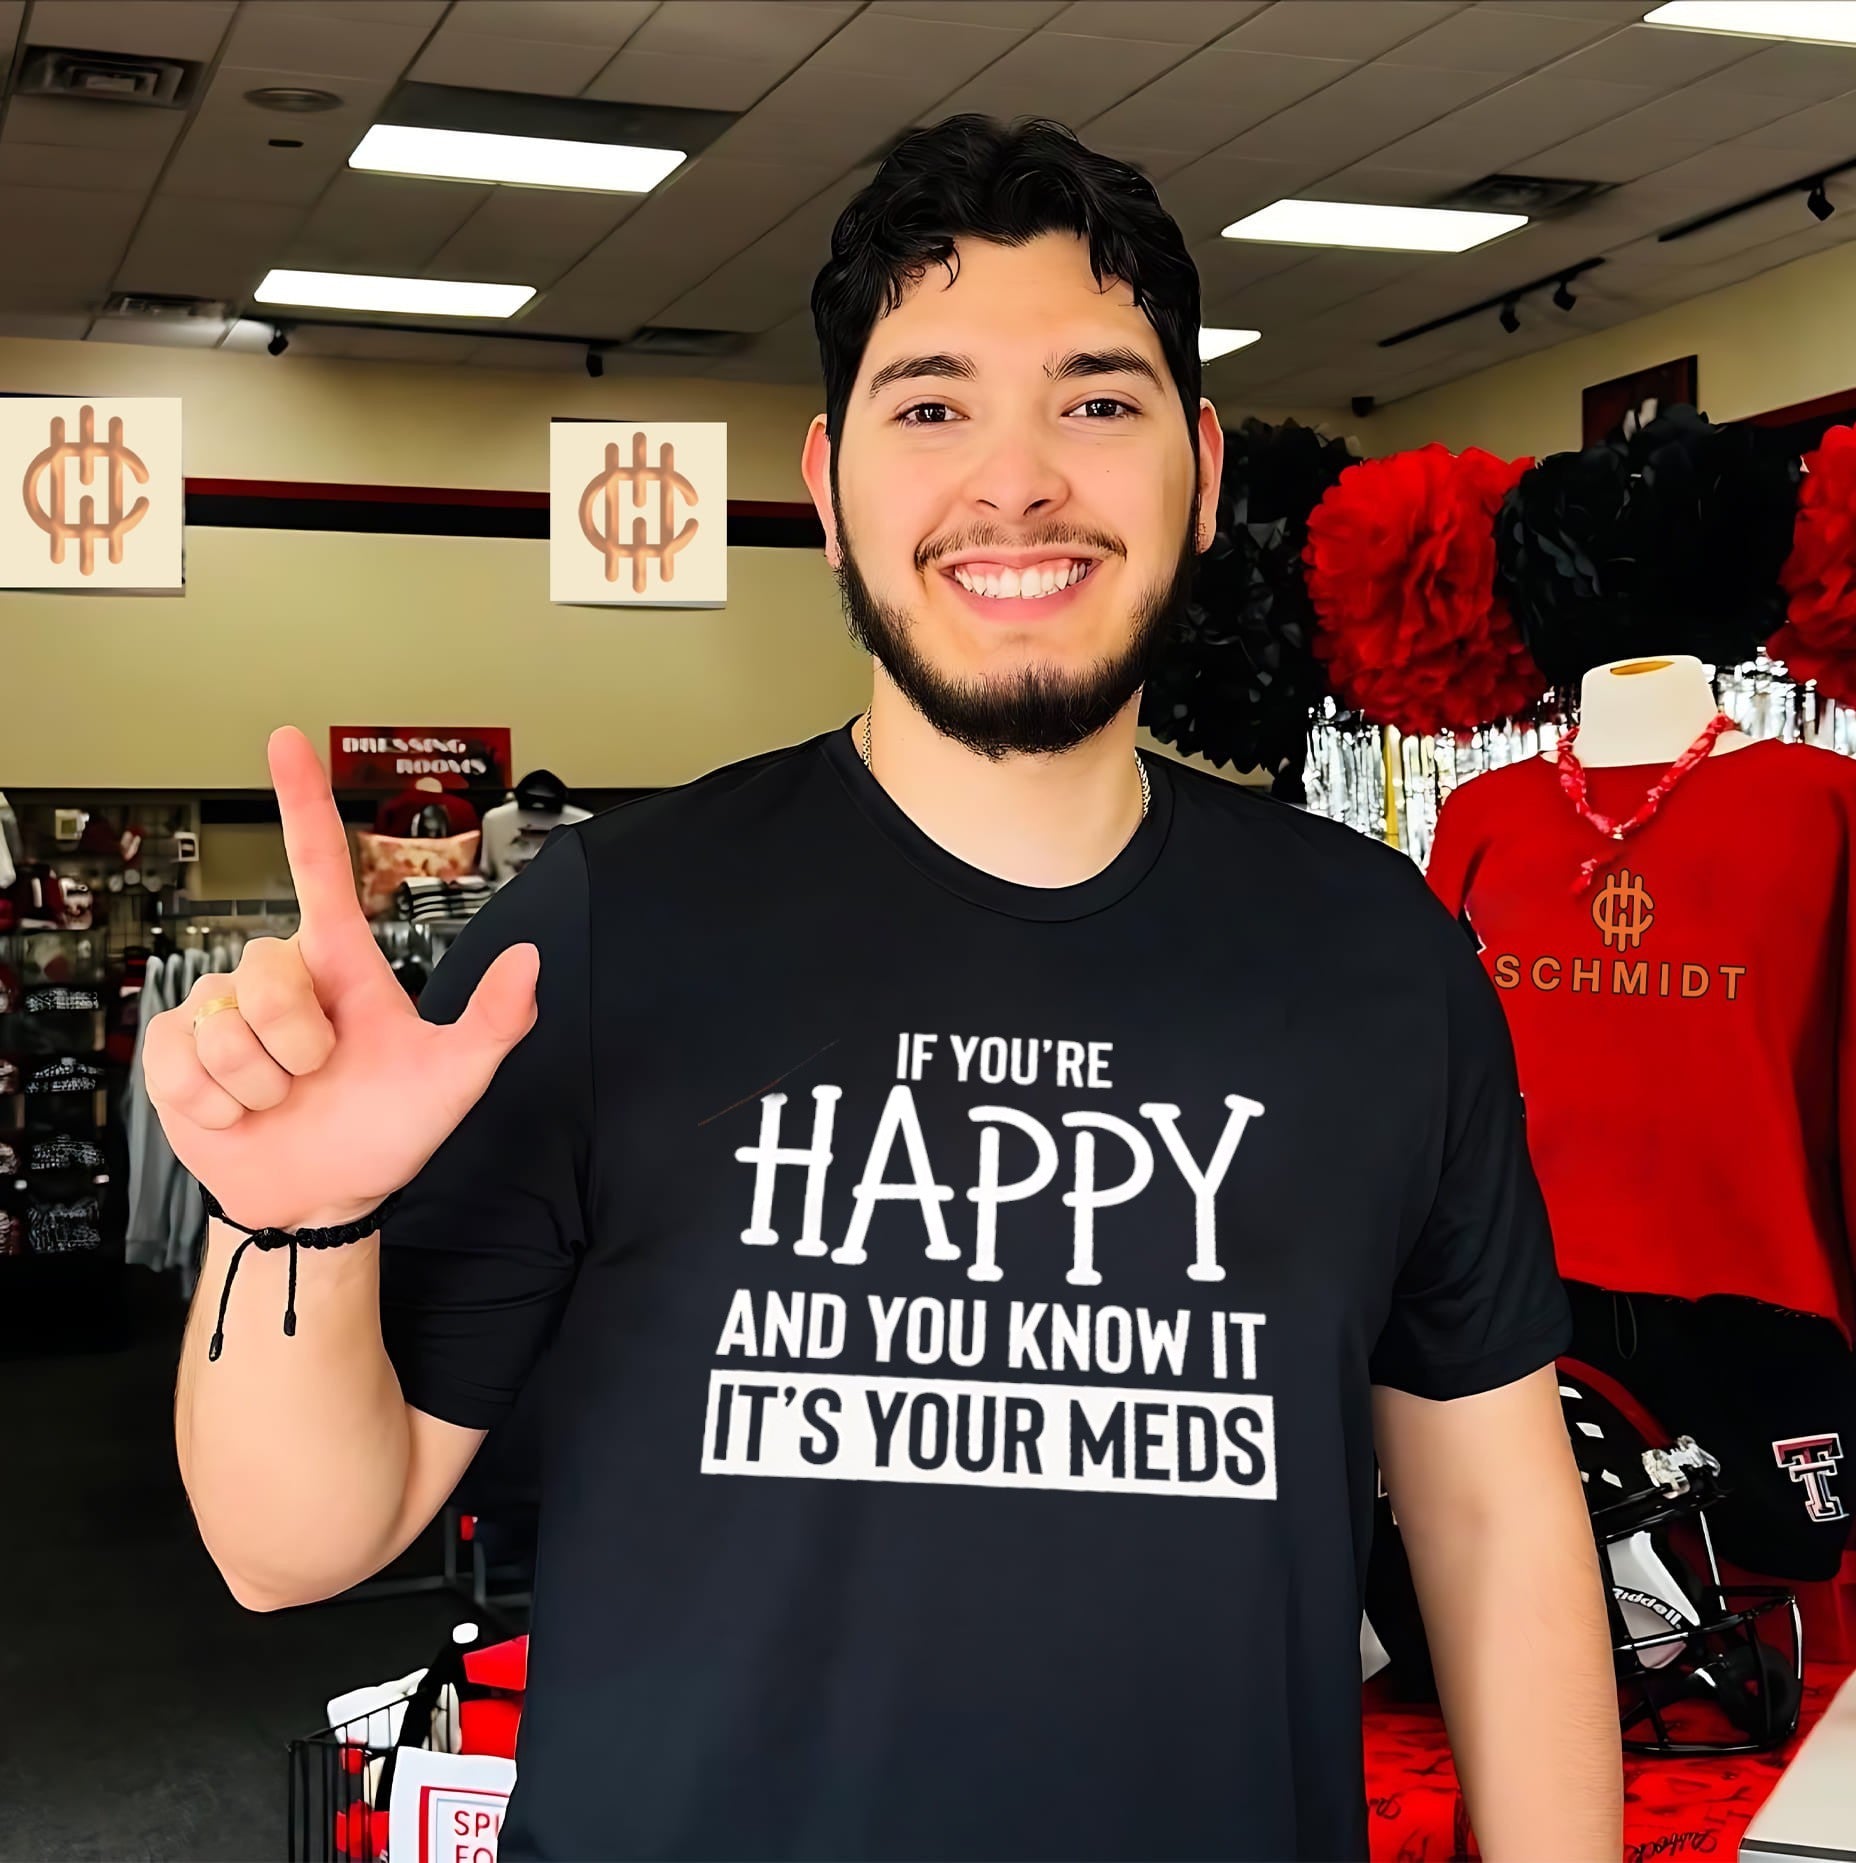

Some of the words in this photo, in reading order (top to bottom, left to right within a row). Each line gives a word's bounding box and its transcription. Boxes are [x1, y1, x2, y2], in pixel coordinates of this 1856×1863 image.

[341, 736, 467, 754] DRESSING
[396, 757, 488, 775] ROOMS
[1494, 953, 1747, 1001] SCHMIDT
[896, 1032, 938, 1081] IF
[949, 1034, 1114, 1089] YOU’RE
[734, 1083, 1266, 1287] HAPPY
[715, 1288, 847, 1360] AND
[867, 1294, 987, 1367] YOU
[1008, 1300, 1191, 1376] KNOW
[1211, 1311, 1267, 1380] IT
[713, 1383, 842, 1466] IT’S
[865, 1390, 1046, 1476] YOUR
[1069, 1399, 1267, 1487] MEDS
